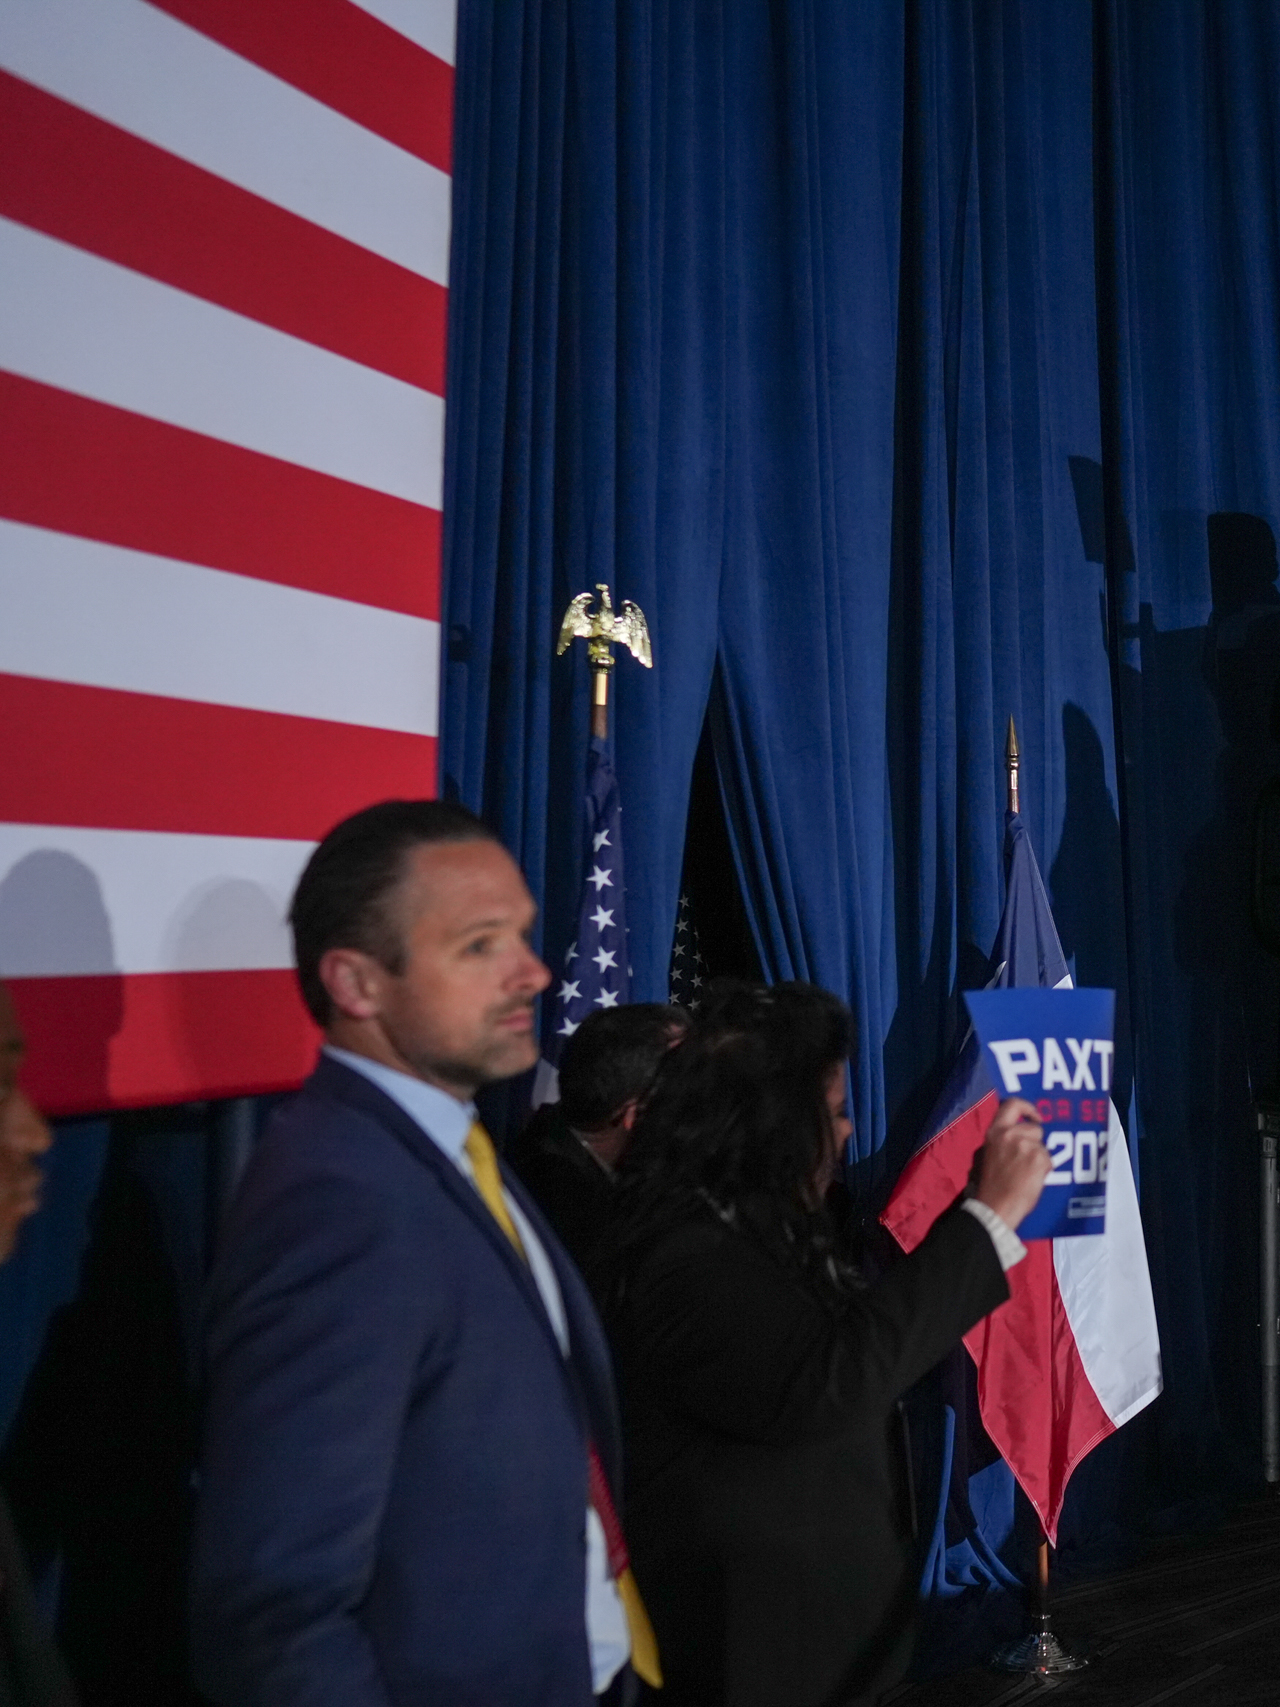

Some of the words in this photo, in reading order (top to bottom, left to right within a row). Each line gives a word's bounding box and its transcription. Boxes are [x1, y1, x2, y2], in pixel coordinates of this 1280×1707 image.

[987, 1037, 1114, 1093] PAXT
[1036, 1099, 1071, 1122] OR
[1043, 1130, 1107, 1185] 20
